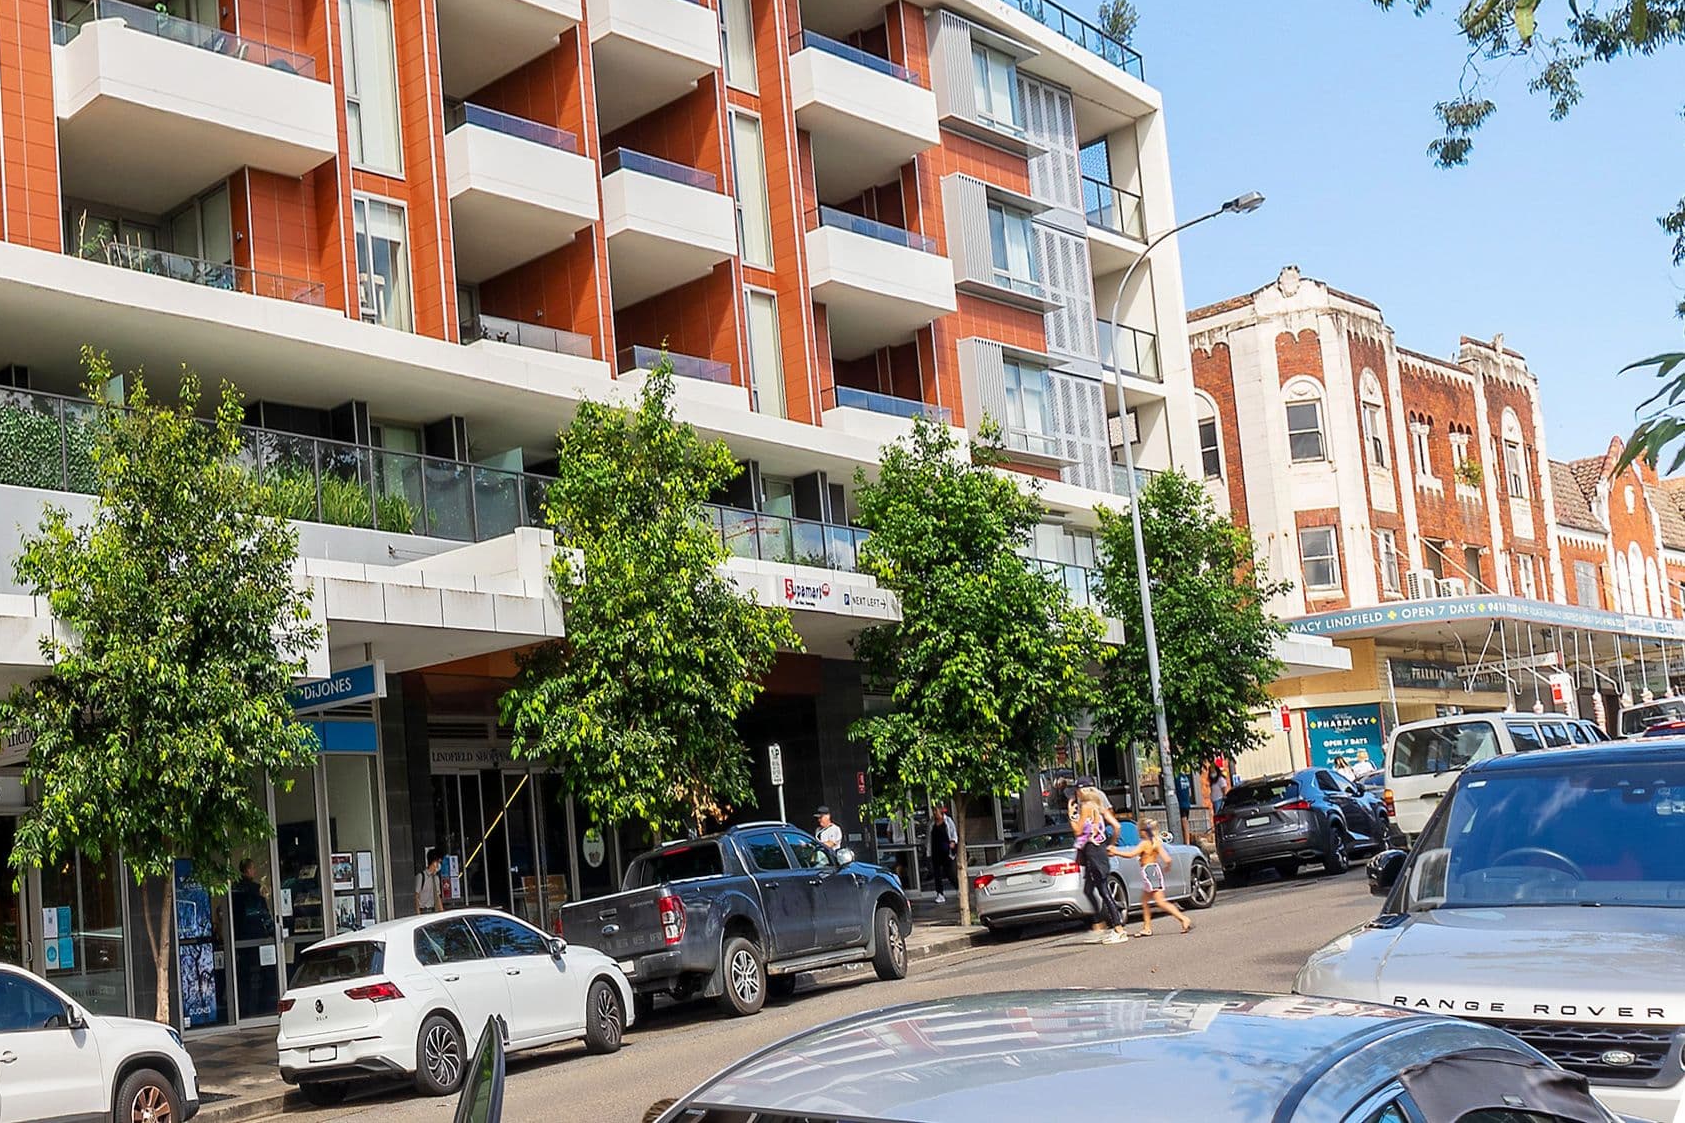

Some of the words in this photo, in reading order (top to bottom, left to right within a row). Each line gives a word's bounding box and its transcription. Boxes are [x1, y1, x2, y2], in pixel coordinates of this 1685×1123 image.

[852, 596, 866, 606] NEXT
[867, 596, 880, 607] LEFT
[1326, 611, 1383, 629] LINDFIELD
[1401, 606, 1435, 619] OPEN
[1438, 605, 1445, 616] 7
[1449, 603, 1476, 614] DAYS
[304, 677, 352, 700] DiJONES
[1317, 717, 1369, 729] PHARMACY
[1323, 738, 1343, 747] OPEN
[1393, 995, 1505, 1013] RANGE
[1533, 1003, 1665, 1019] ROVER
